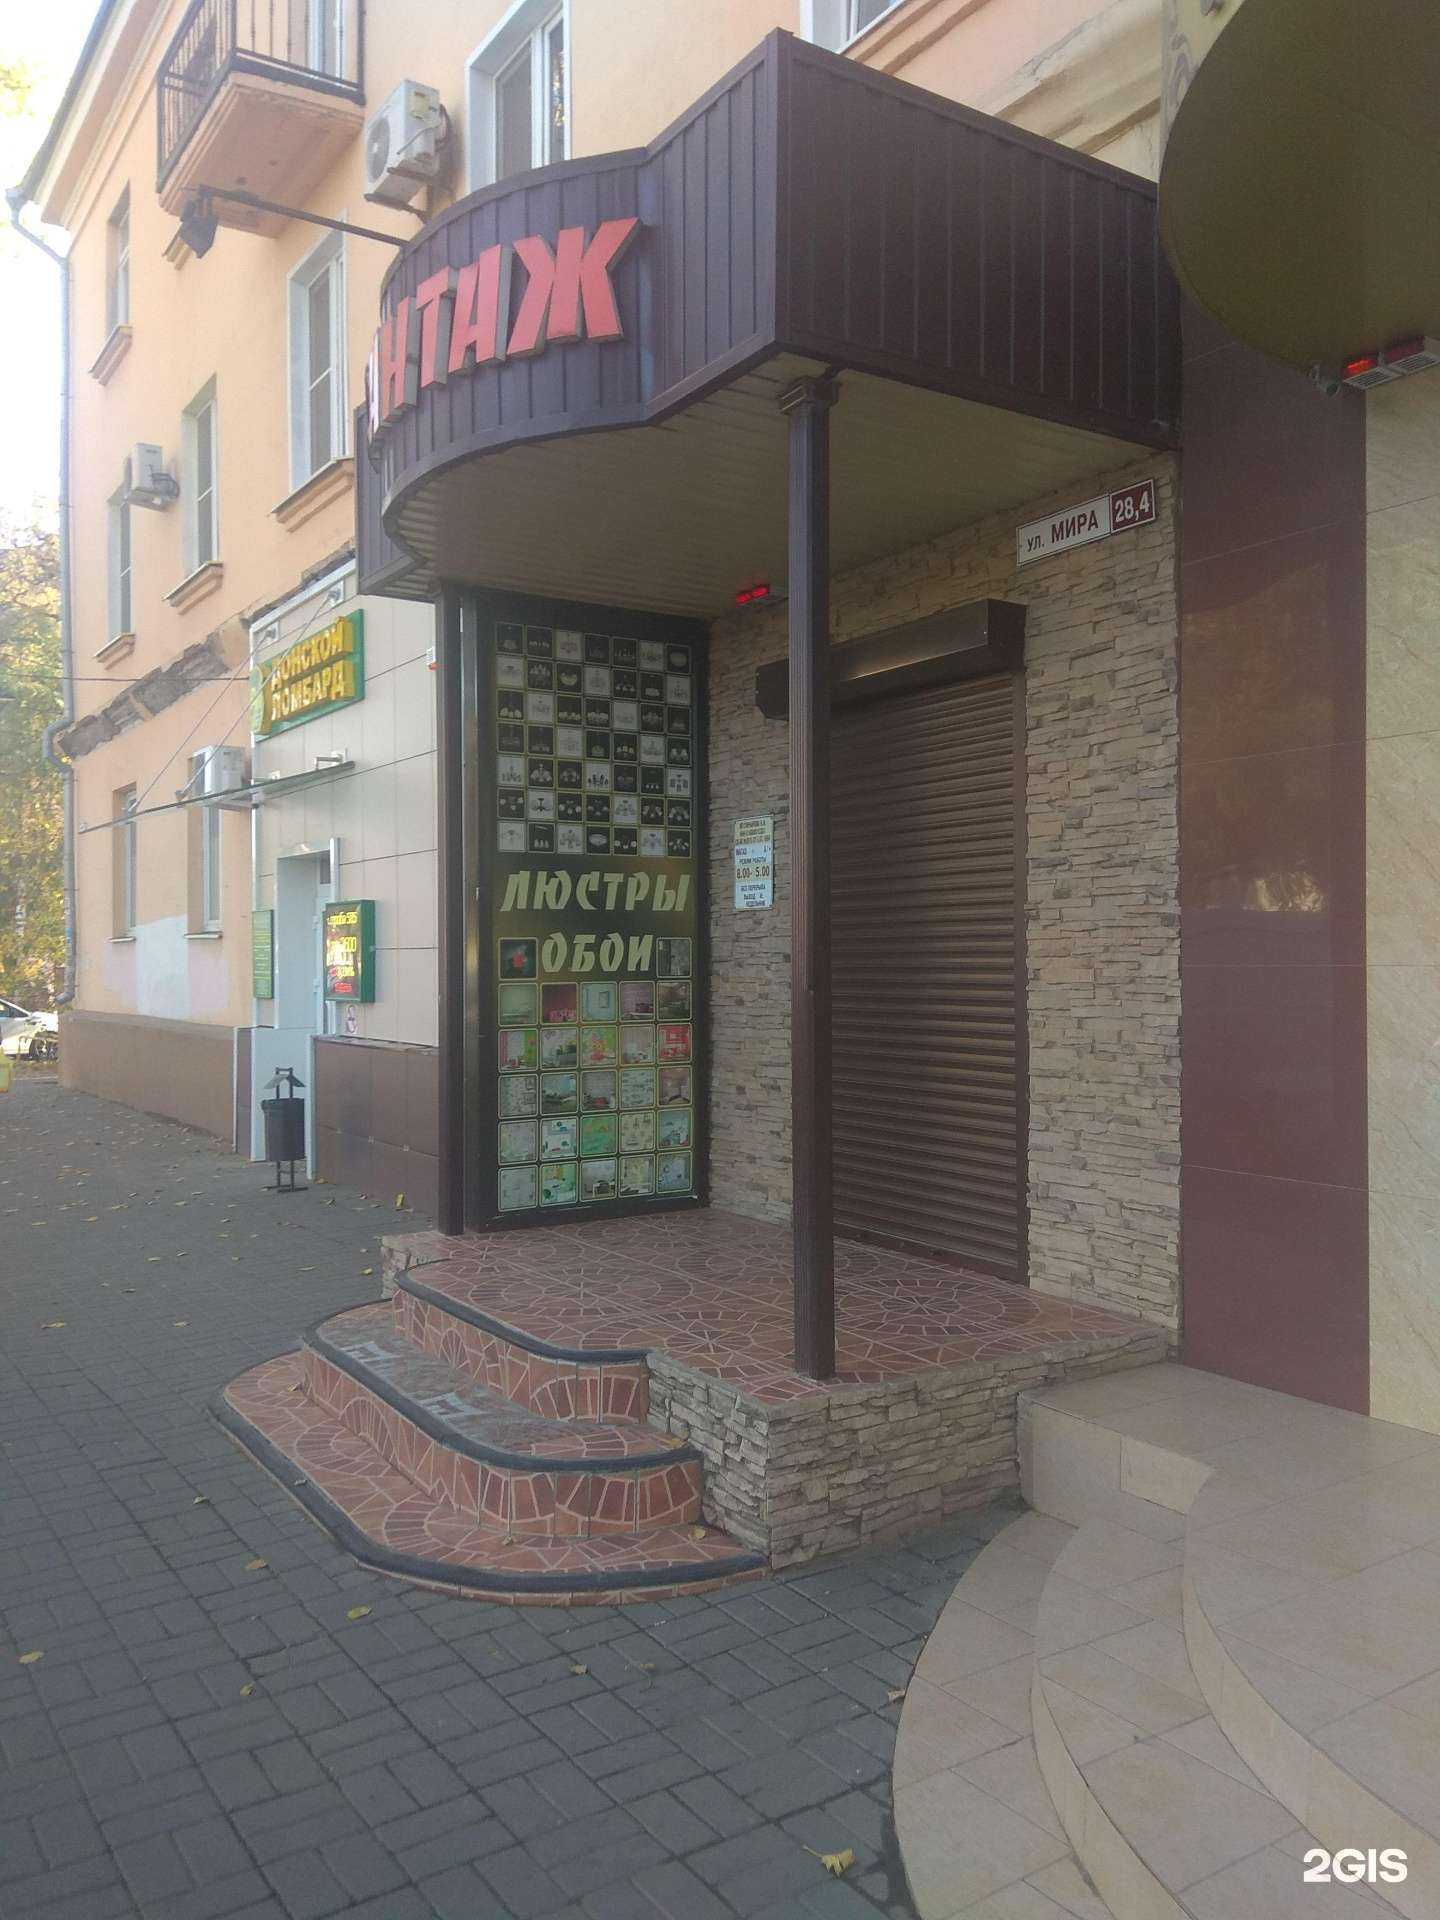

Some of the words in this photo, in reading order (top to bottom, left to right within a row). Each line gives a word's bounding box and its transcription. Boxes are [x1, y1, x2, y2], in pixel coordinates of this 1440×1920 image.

[1027, 535, 1045, 552] ул.
[1051, 510, 1099, 543] МИРА
[1114, 490, 1150, 523] 28,4
[271, 659, 347, 721] ЛОМБАРД
[500, 870, 691, 912] ЛЮСТРЫ
[541, 931, 654, 973] ОБОИ
